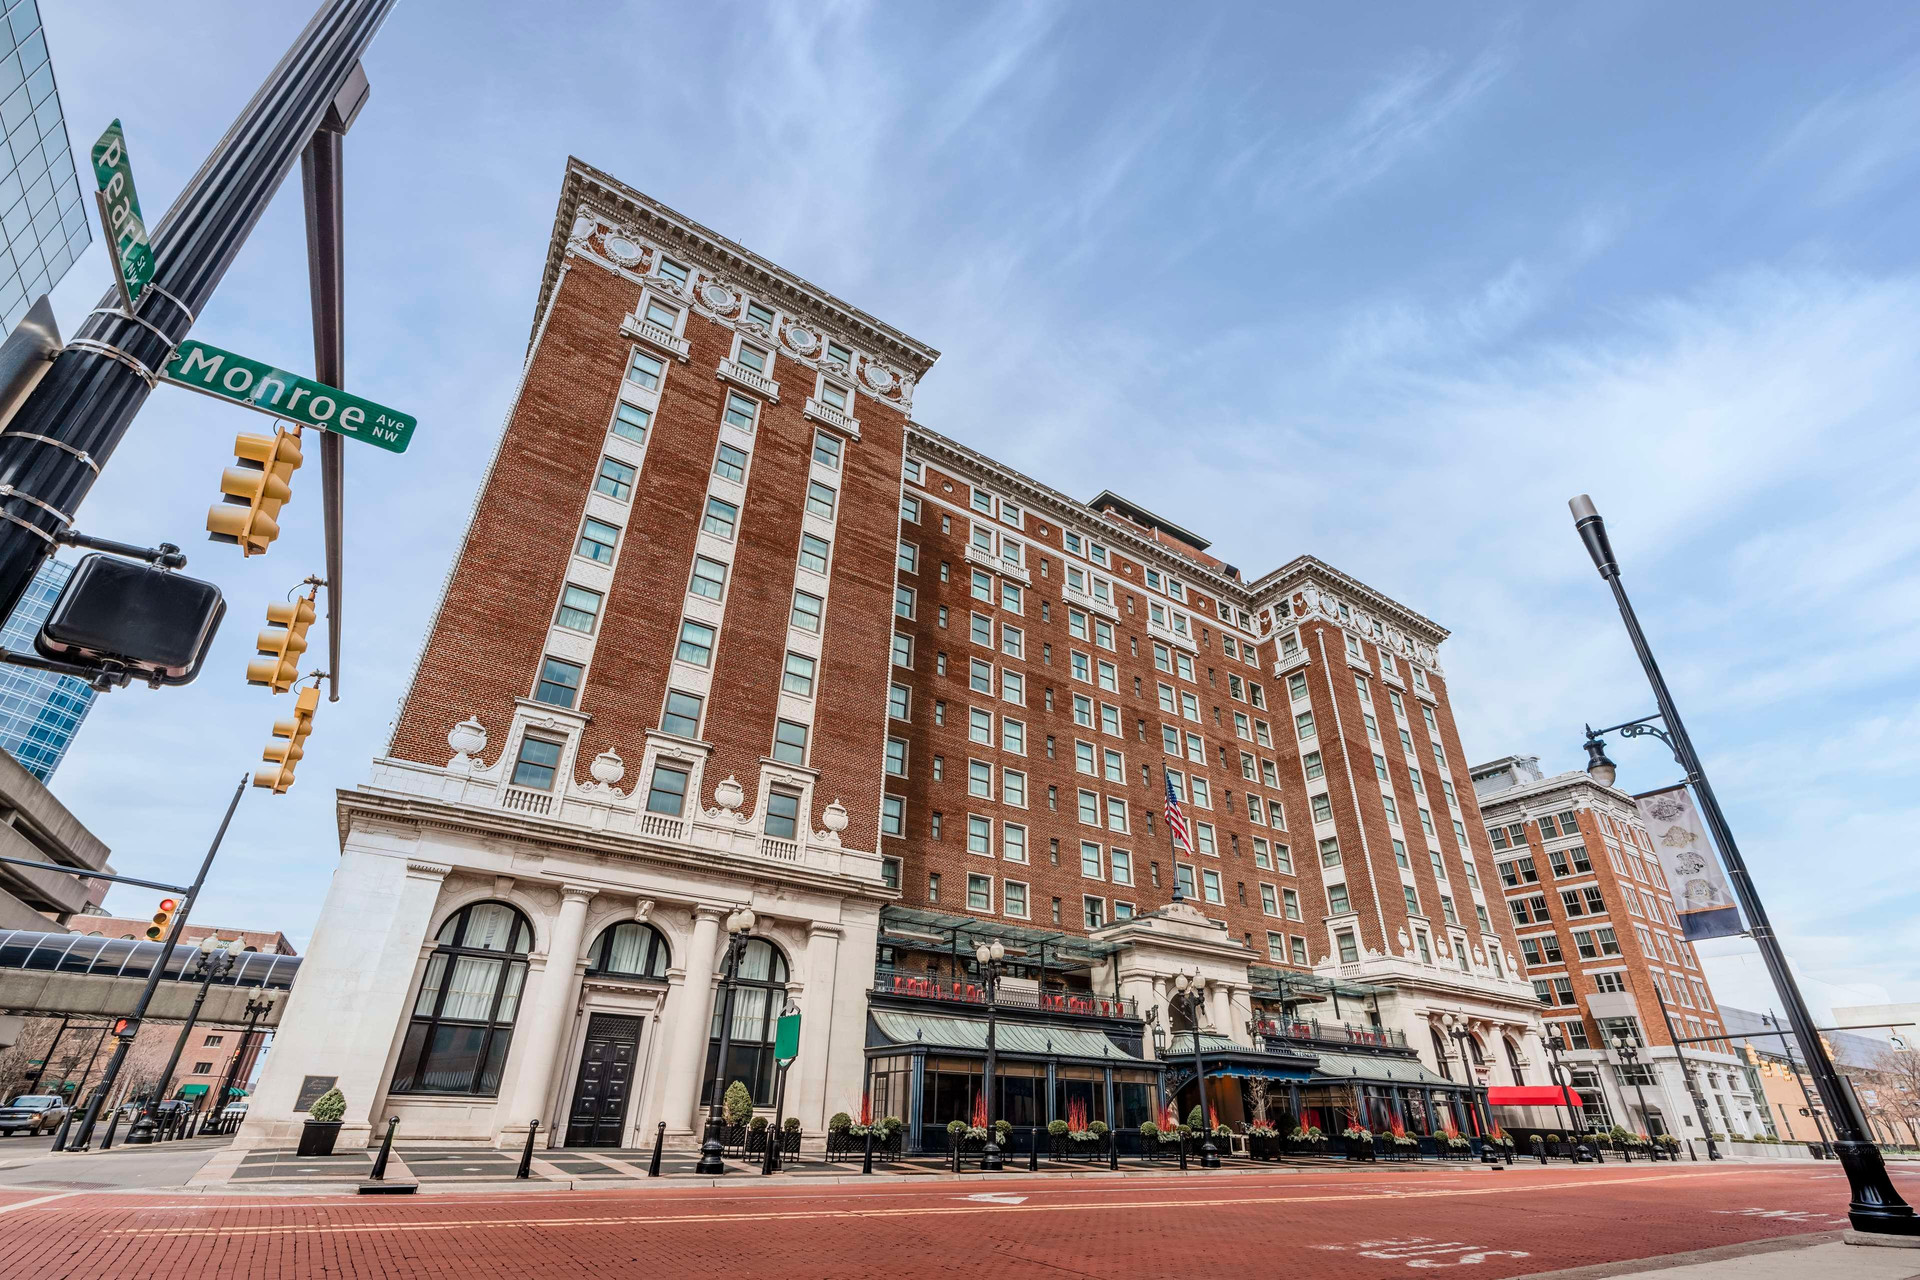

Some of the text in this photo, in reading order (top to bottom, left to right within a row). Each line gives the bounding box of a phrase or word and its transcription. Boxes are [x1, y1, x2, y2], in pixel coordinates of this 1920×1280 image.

[98, 137, 143, 262] Pearl
[137, 255, 146, 272] St
[127, 262, 139, 287] NW
[179, 347, 366, 432] Monroe
[375, 413, 405, 431] Ave
[371, 428, 400, 443] NW
